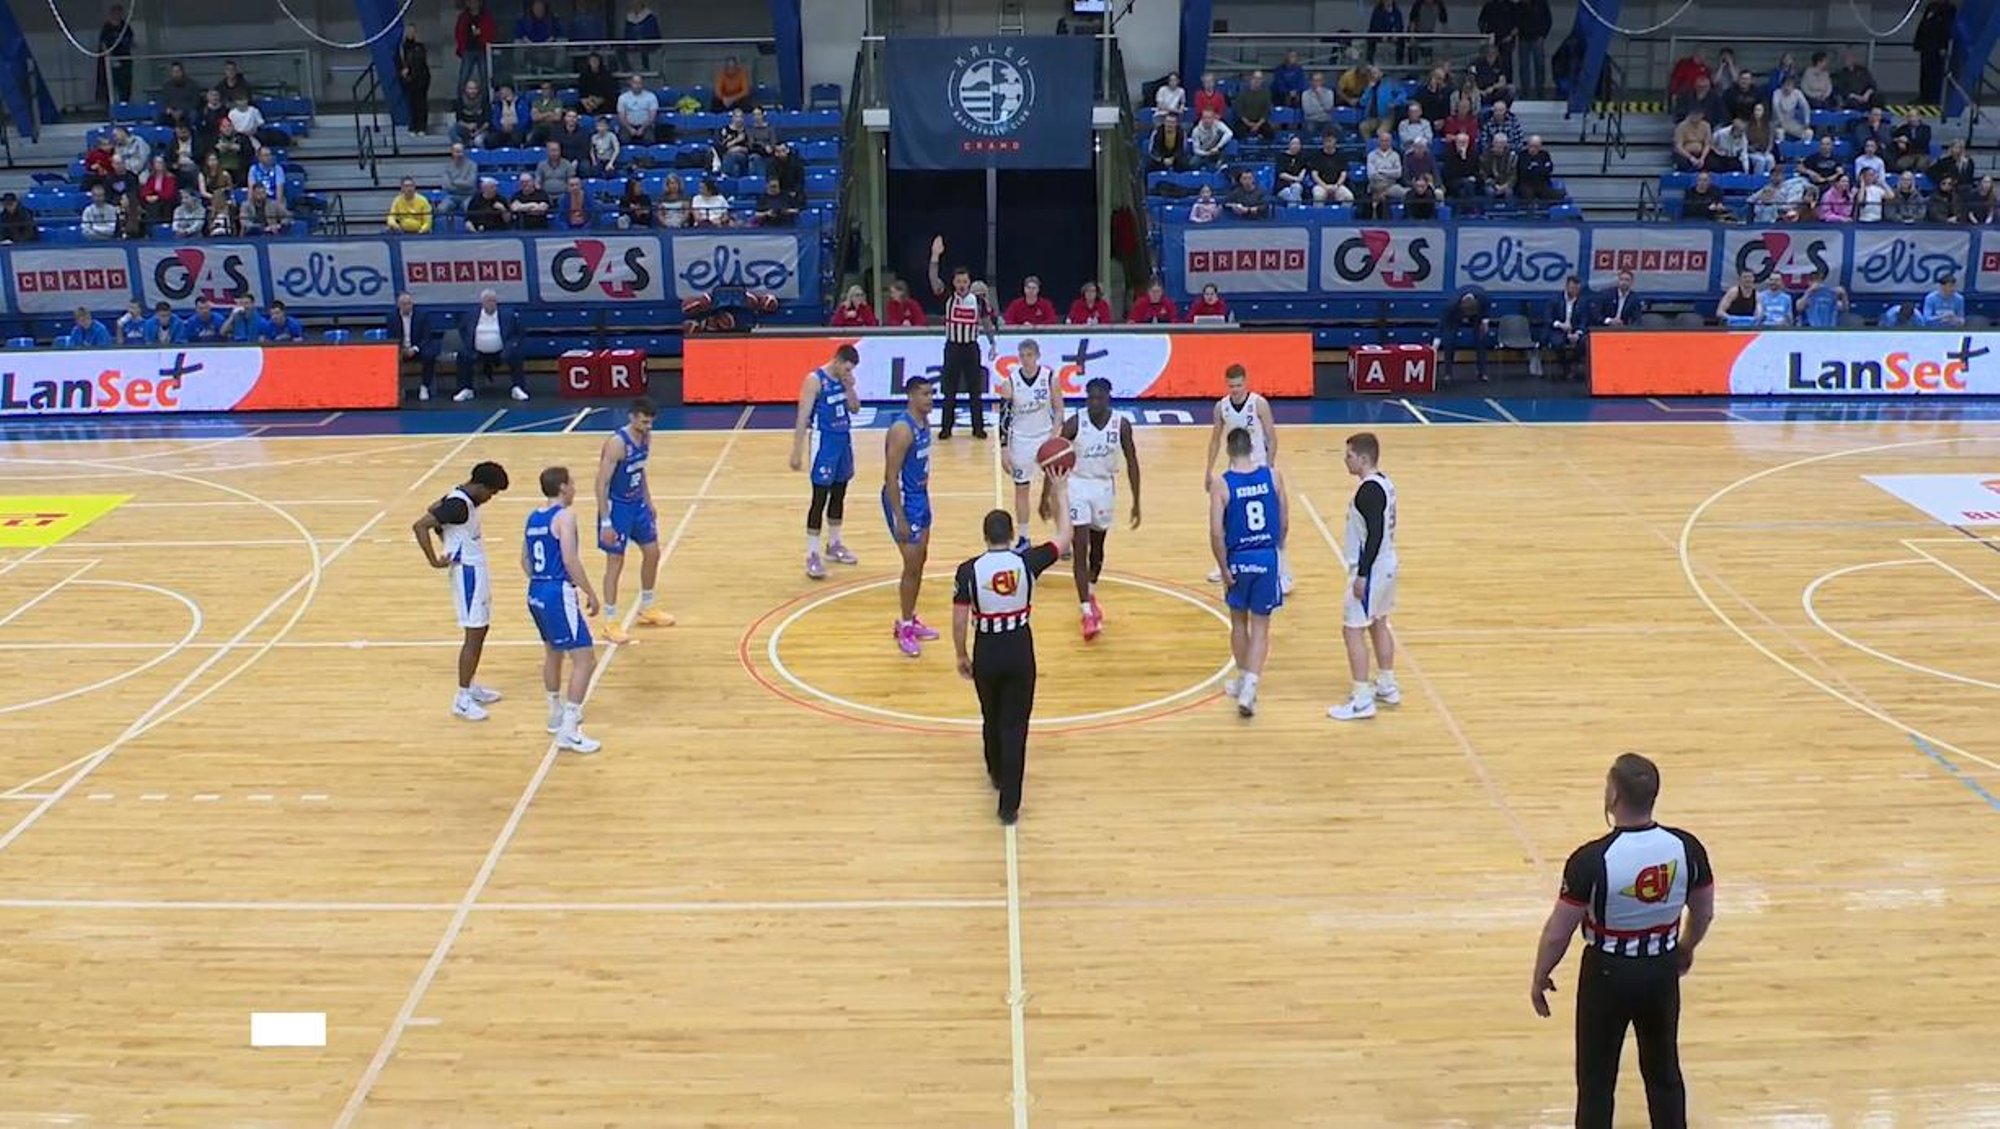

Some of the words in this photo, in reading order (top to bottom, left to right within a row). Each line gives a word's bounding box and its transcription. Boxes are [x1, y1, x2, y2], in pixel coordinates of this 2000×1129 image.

[963, 141, 1020, 151] CRAMO
[277, 252, 388, 297] elisa
[411, 263, 519, 280] CRAMO
[551, 239, 650, 298] G4S
[680, 244, 793, 290] elisa
[1192, 253, 1301, 269] CRAMO
[1333, 229, 1432, 288] G4S
[1461, 236, 1573, 282] elisa
[1598, 253, 1704, 268] CRAMO
[1736, 232, 1829, 289] G4S
[1857, 238, 1962, 284] elisa
[20, 272, 124, 290] CRAMO
[154, 249, 249, 303] G4S
[1034, 389, 1047, 400] 32
[1246, 415, 1254, 426] 2
[1106, 431, 1118, 444] 13
[1246, 500, 1266, 532] 8
[532, 540, 546, 572] 9
